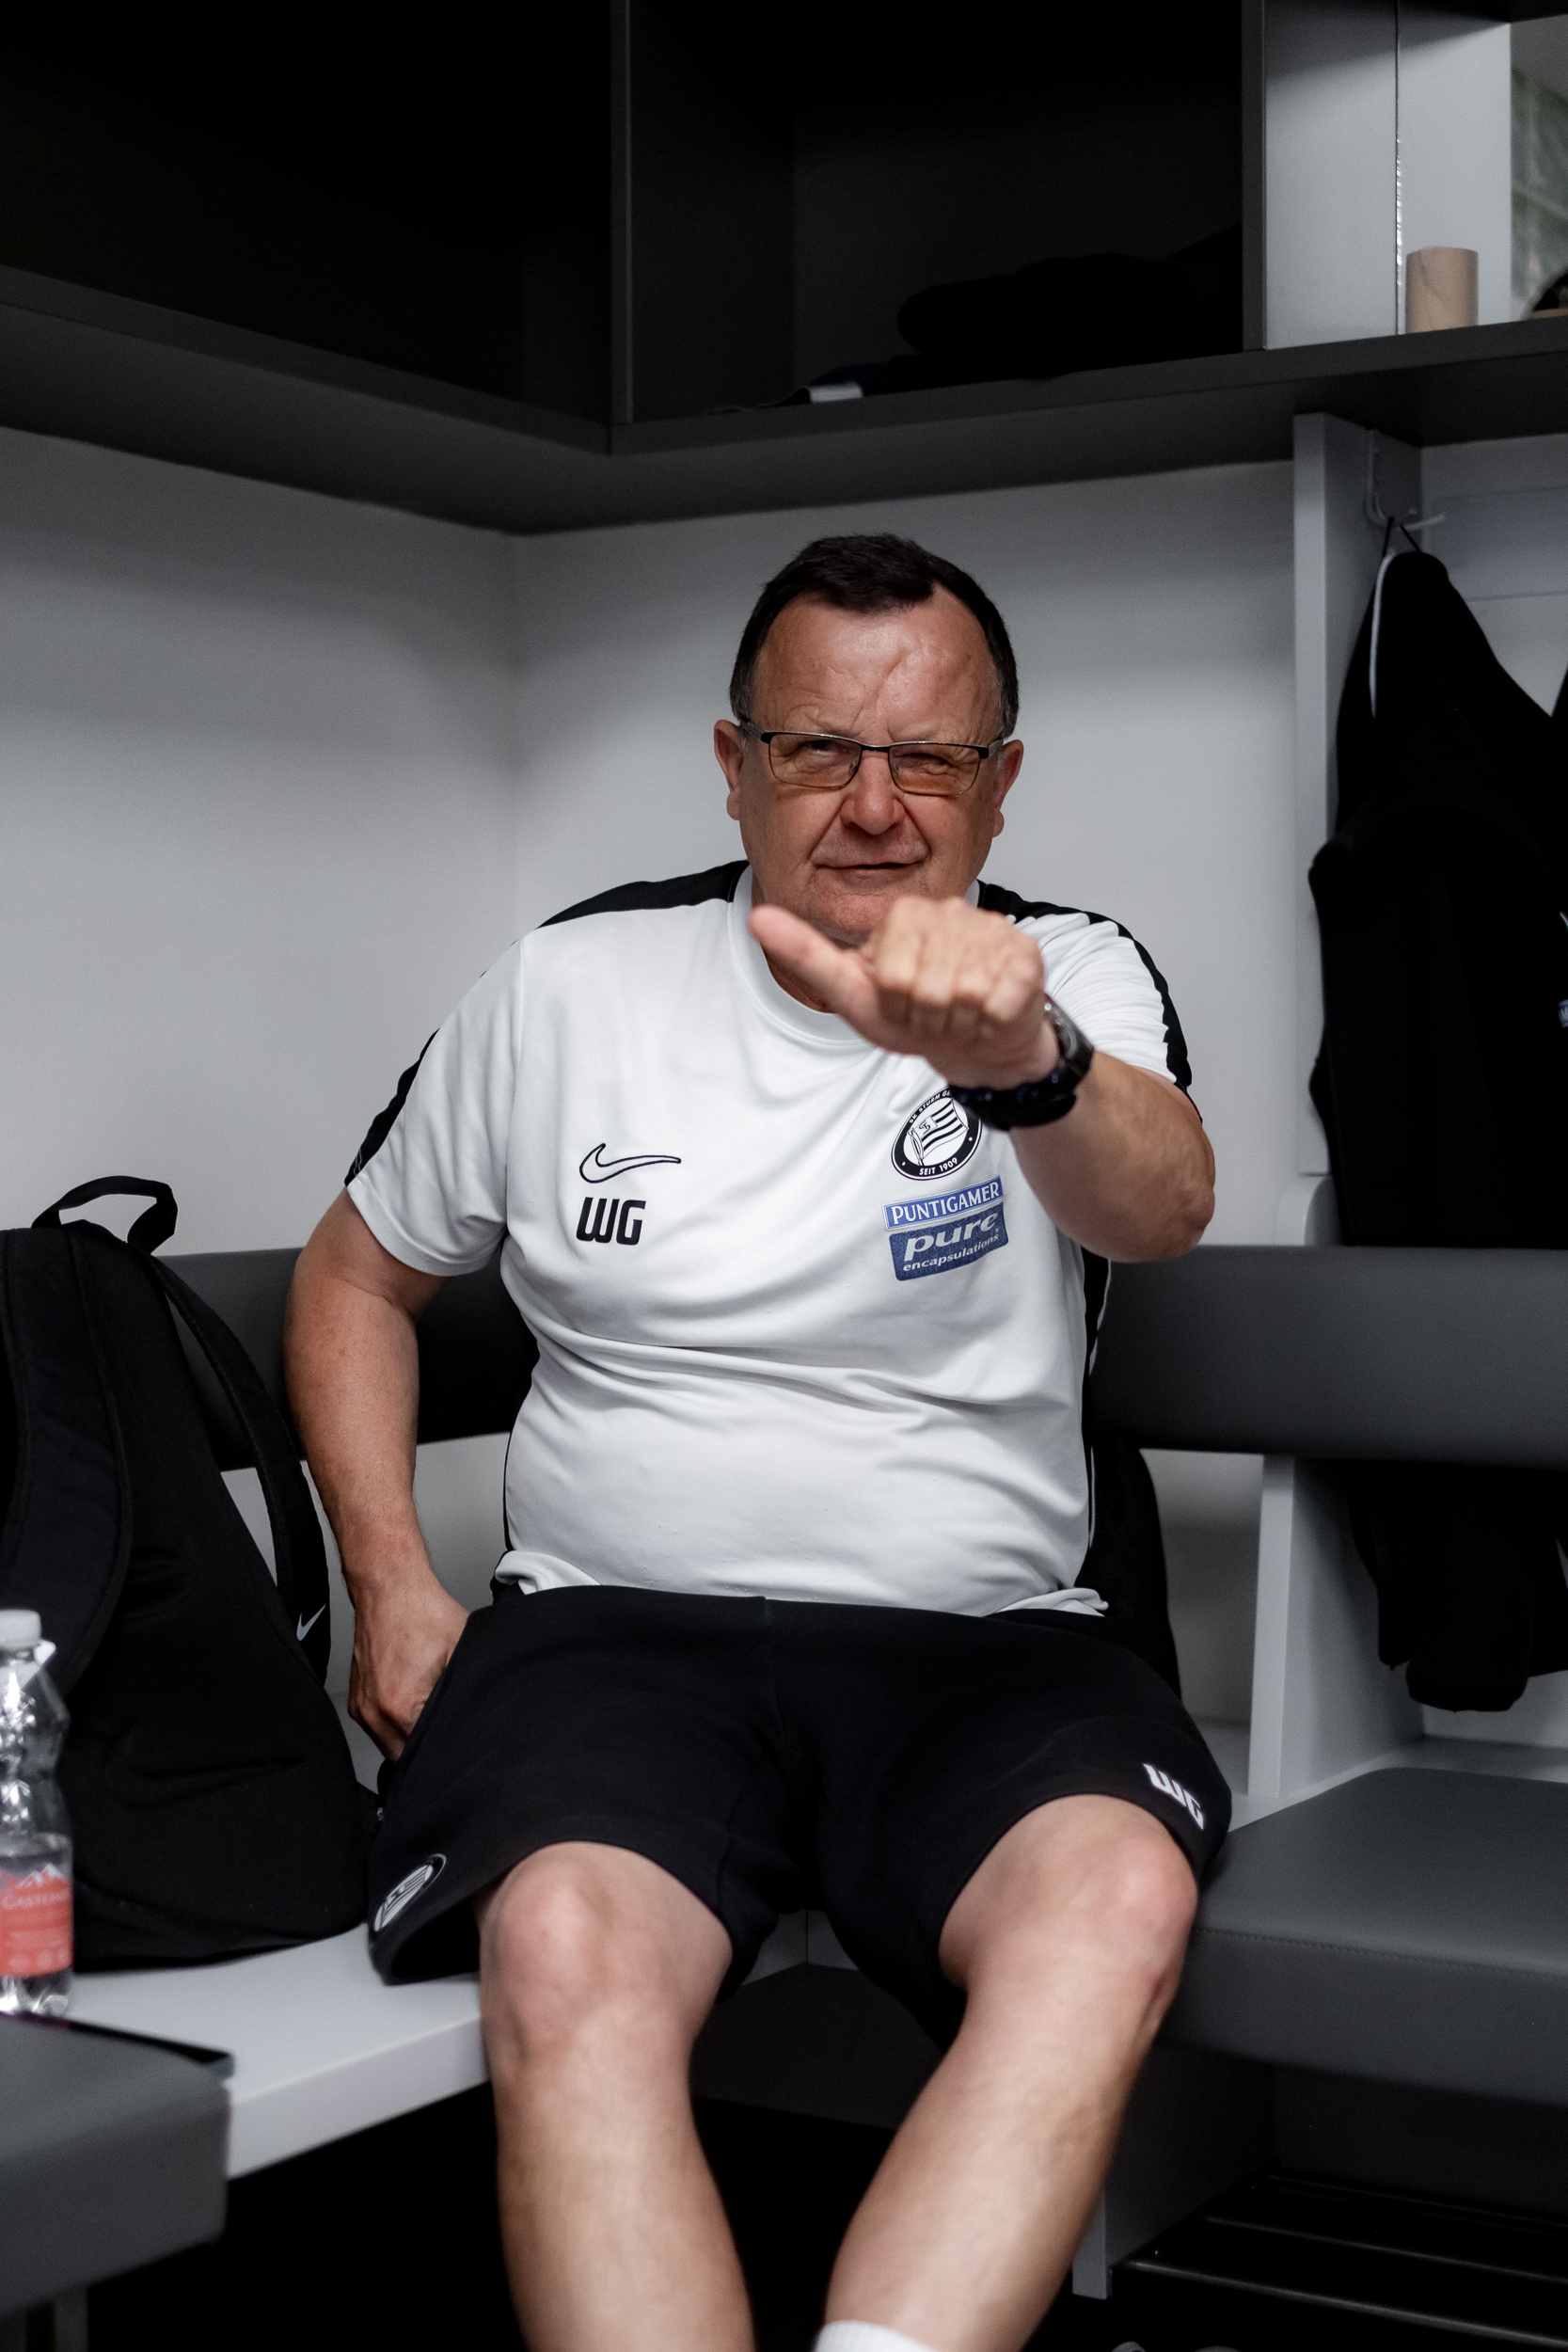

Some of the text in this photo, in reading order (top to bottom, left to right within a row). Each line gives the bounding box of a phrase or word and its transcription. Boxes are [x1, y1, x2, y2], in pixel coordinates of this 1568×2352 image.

[909, 1114, 918, 1124] SK
[918, 1093, 941, 1113] STURM
[919, 1157, 958, 1176] SEIT 1909
[576, 1197, 647, 1246] WG
[891, 1182, 1000, 1225] PUNTIGAMER
[903, 1234, 999, 1272] encapsulations
[904, 1213, 998, 1263] pure
[1142, 1763, 1204, 1831] WG
